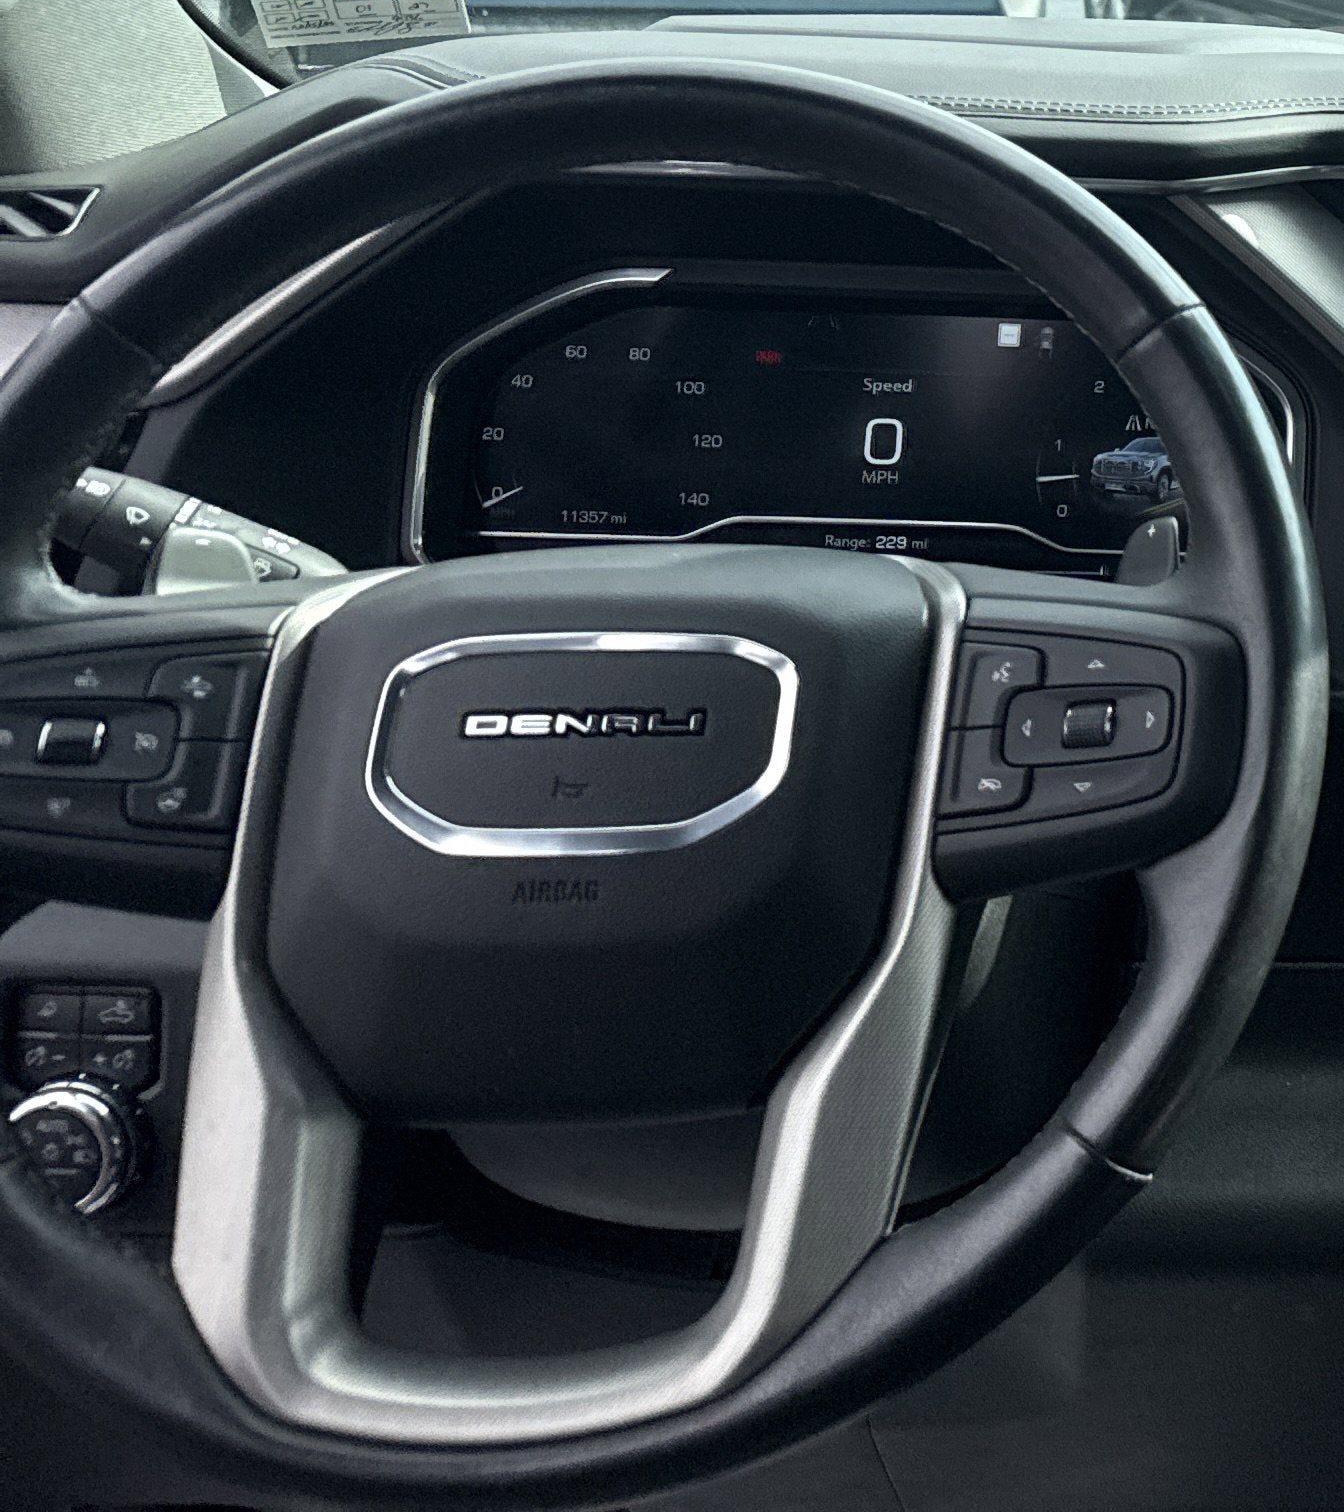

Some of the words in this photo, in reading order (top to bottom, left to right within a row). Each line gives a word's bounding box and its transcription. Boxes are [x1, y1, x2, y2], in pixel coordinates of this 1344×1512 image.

[565, 345, 588, 359] 60
[629, 347, 651, 361] 80
[511, 374, 533, 388] 40
[675, 381, 705, 395] 100
[863, 377, 913, 395] Speed
[1094, 380, 1105, 394] 2
[482, 427, 504, 441] 20
[692, 434, 722, 448] 120
[863, 417, 904, 466] 0
[1055, 438, 1063, 452] 1
[861, 470, 899, 485] MPH
[678, 492, 709, 506] 140
[561, 510, 608, 524] 11357
[610, 512, 627, 524] mi
[1056, 504, 1068, 518] 0
[825, 534, 871, 550] Range:
[875, 535, 907, 549] 229
[911, 536, 929, 550] mi
[464, 711, 706, 737] DENALI
[511, 879, 600, 906] AIRBAG
